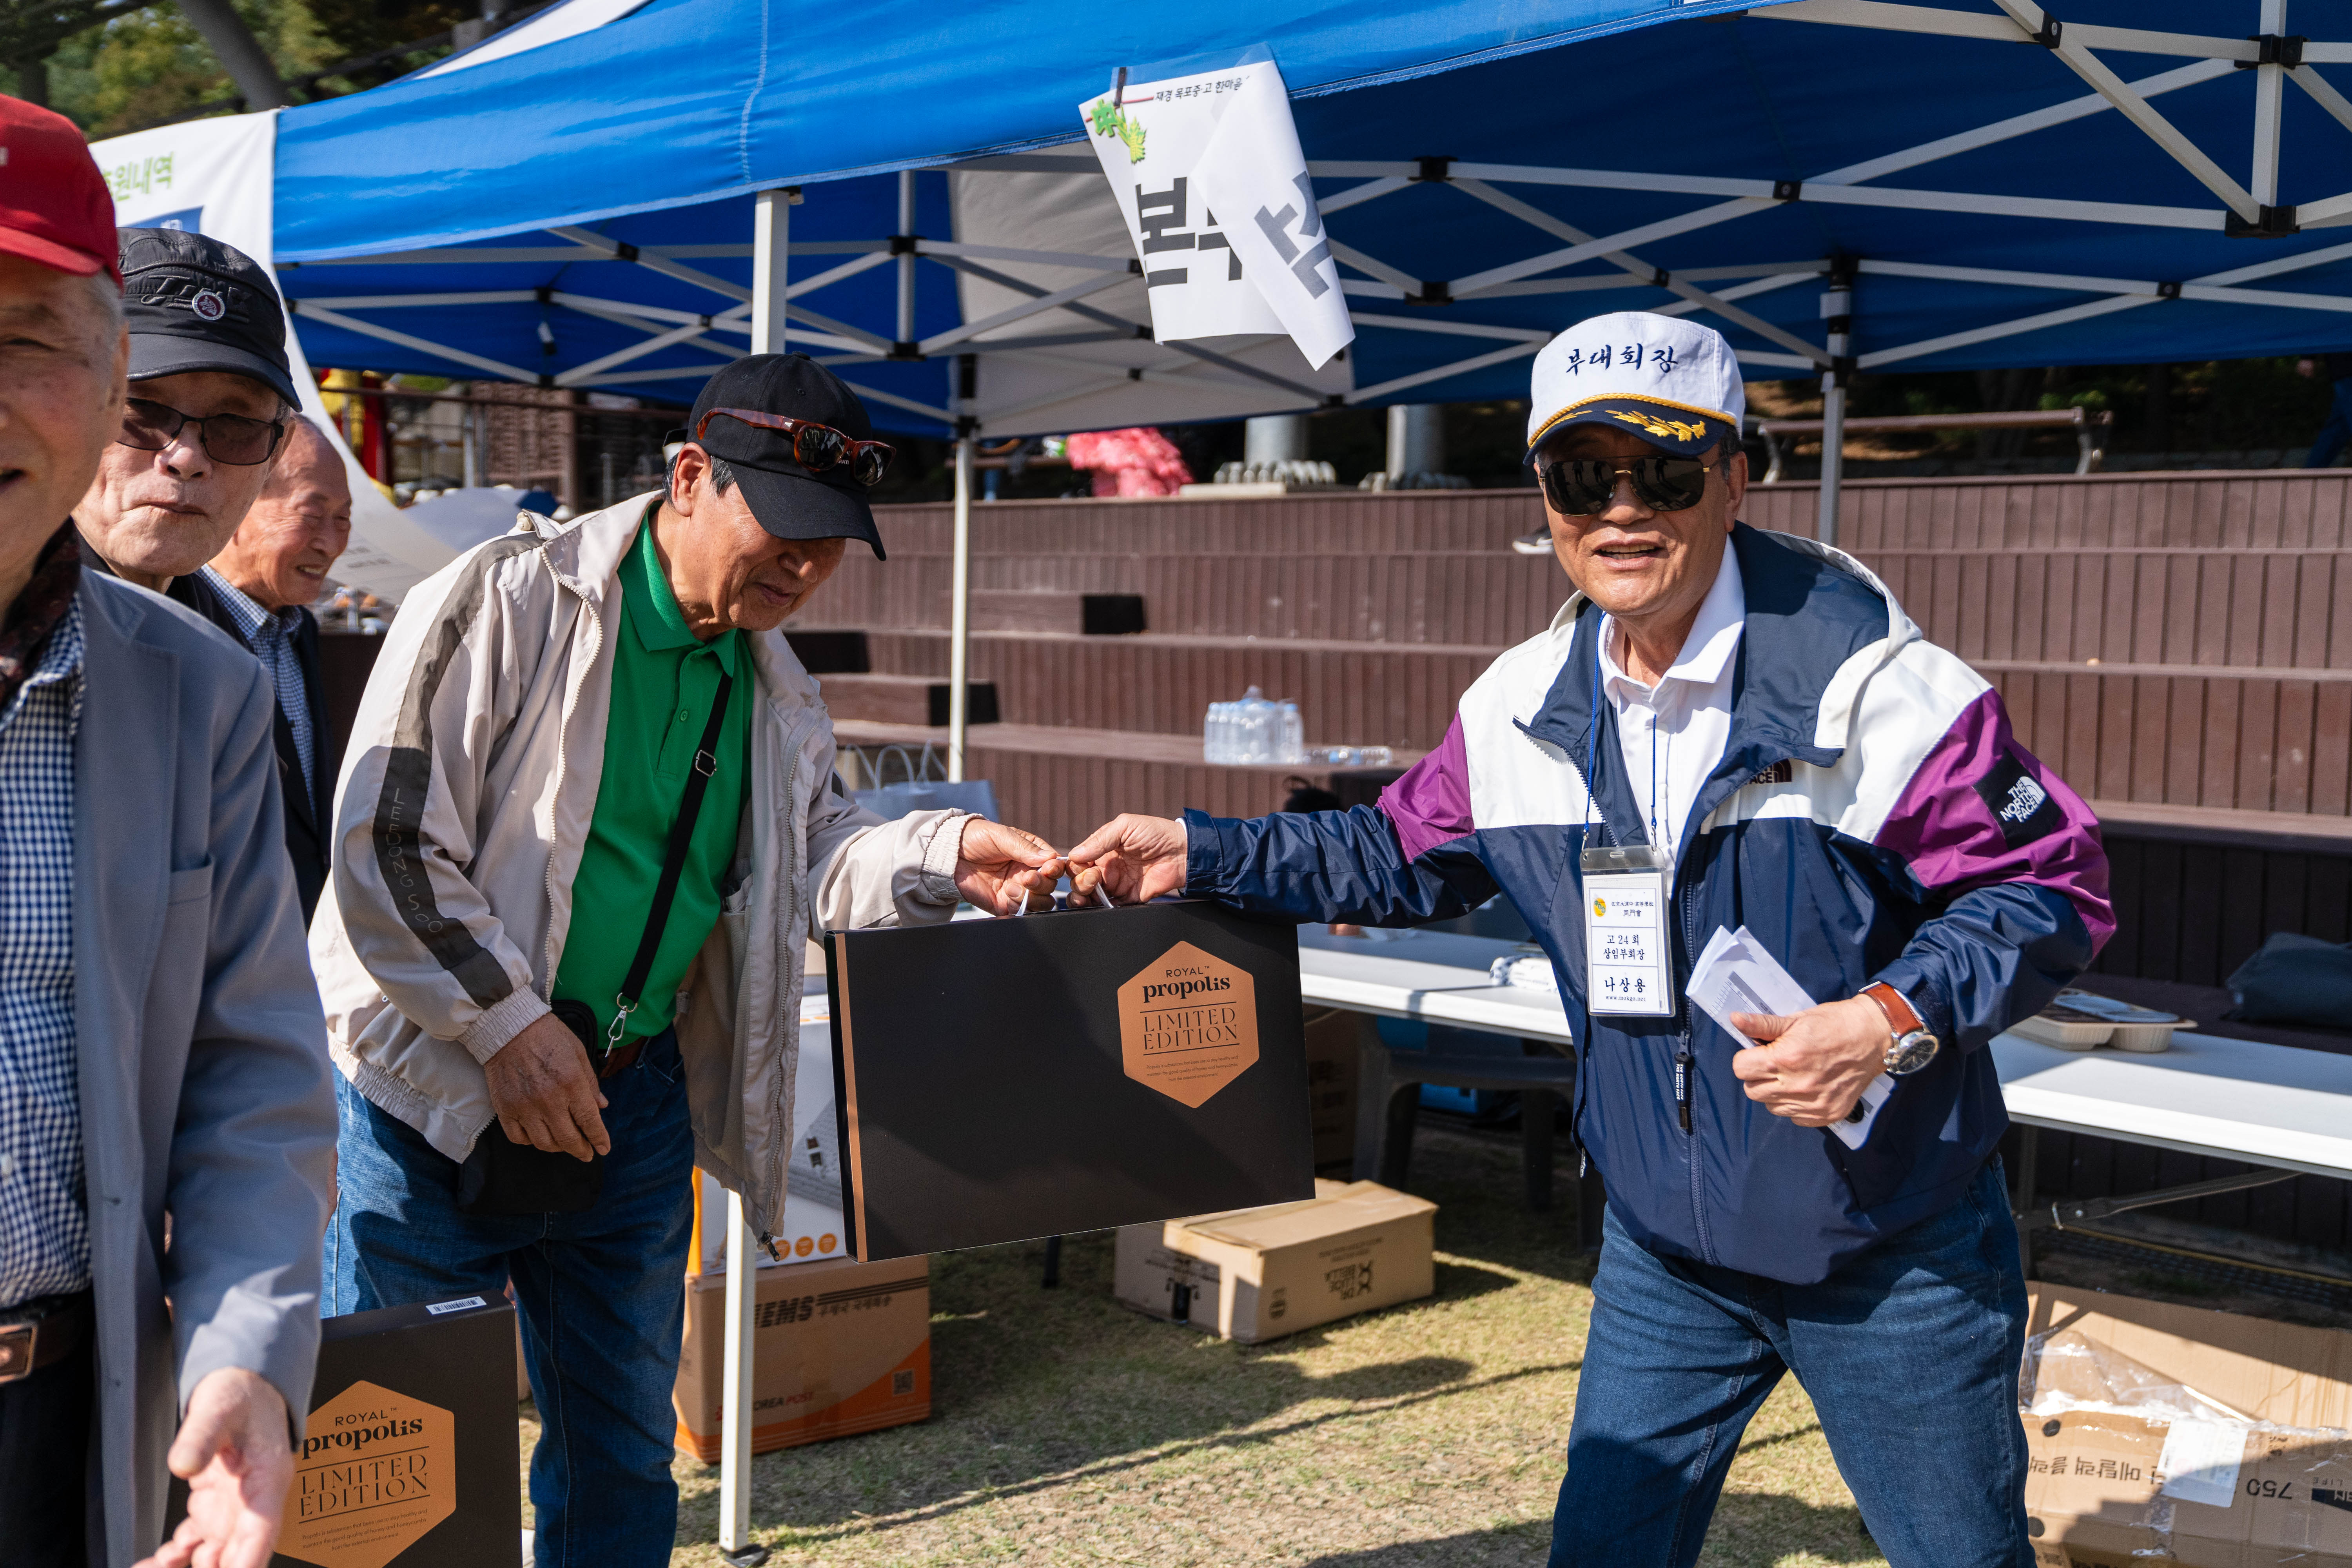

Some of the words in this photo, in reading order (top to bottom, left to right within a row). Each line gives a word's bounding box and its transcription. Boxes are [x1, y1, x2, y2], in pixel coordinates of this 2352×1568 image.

[1156, 90, 1172, 102] 재경
[1566, 343, 1678, 376] 부대회장
[1749, 772, 1773, 784] ACE
[2007, 780, 2026, 799] THE
[2000, 789, 2032, 821] NORTH
[2015, 798, 2038, 822] FACE
[385, 833, 414, 887] DONG
[408, 894, 443, 933] SOO
[1603, 947, 1645, 960] 상임부회장
[1166, 967, 1203, 978] ROYAL
[1142, 976, 1230, 1003] propolis
[1144, 1008, 1235, 1032] LIMITED
[1144, 1024, 1237, 1050] EDITION
[753, 1397, 784, 1411] OREA
[335, 1410, 388, 1426] ROYAL
[302, 1418, 423, 1460] propolis
[302, 1454, 426, 1495] LIMITED
[2075, 1456, 2141, 1481] 메탈랙
[301, 1473, 428, 1516] EDITION
[2246, 1478, 2293, 1500] 750
